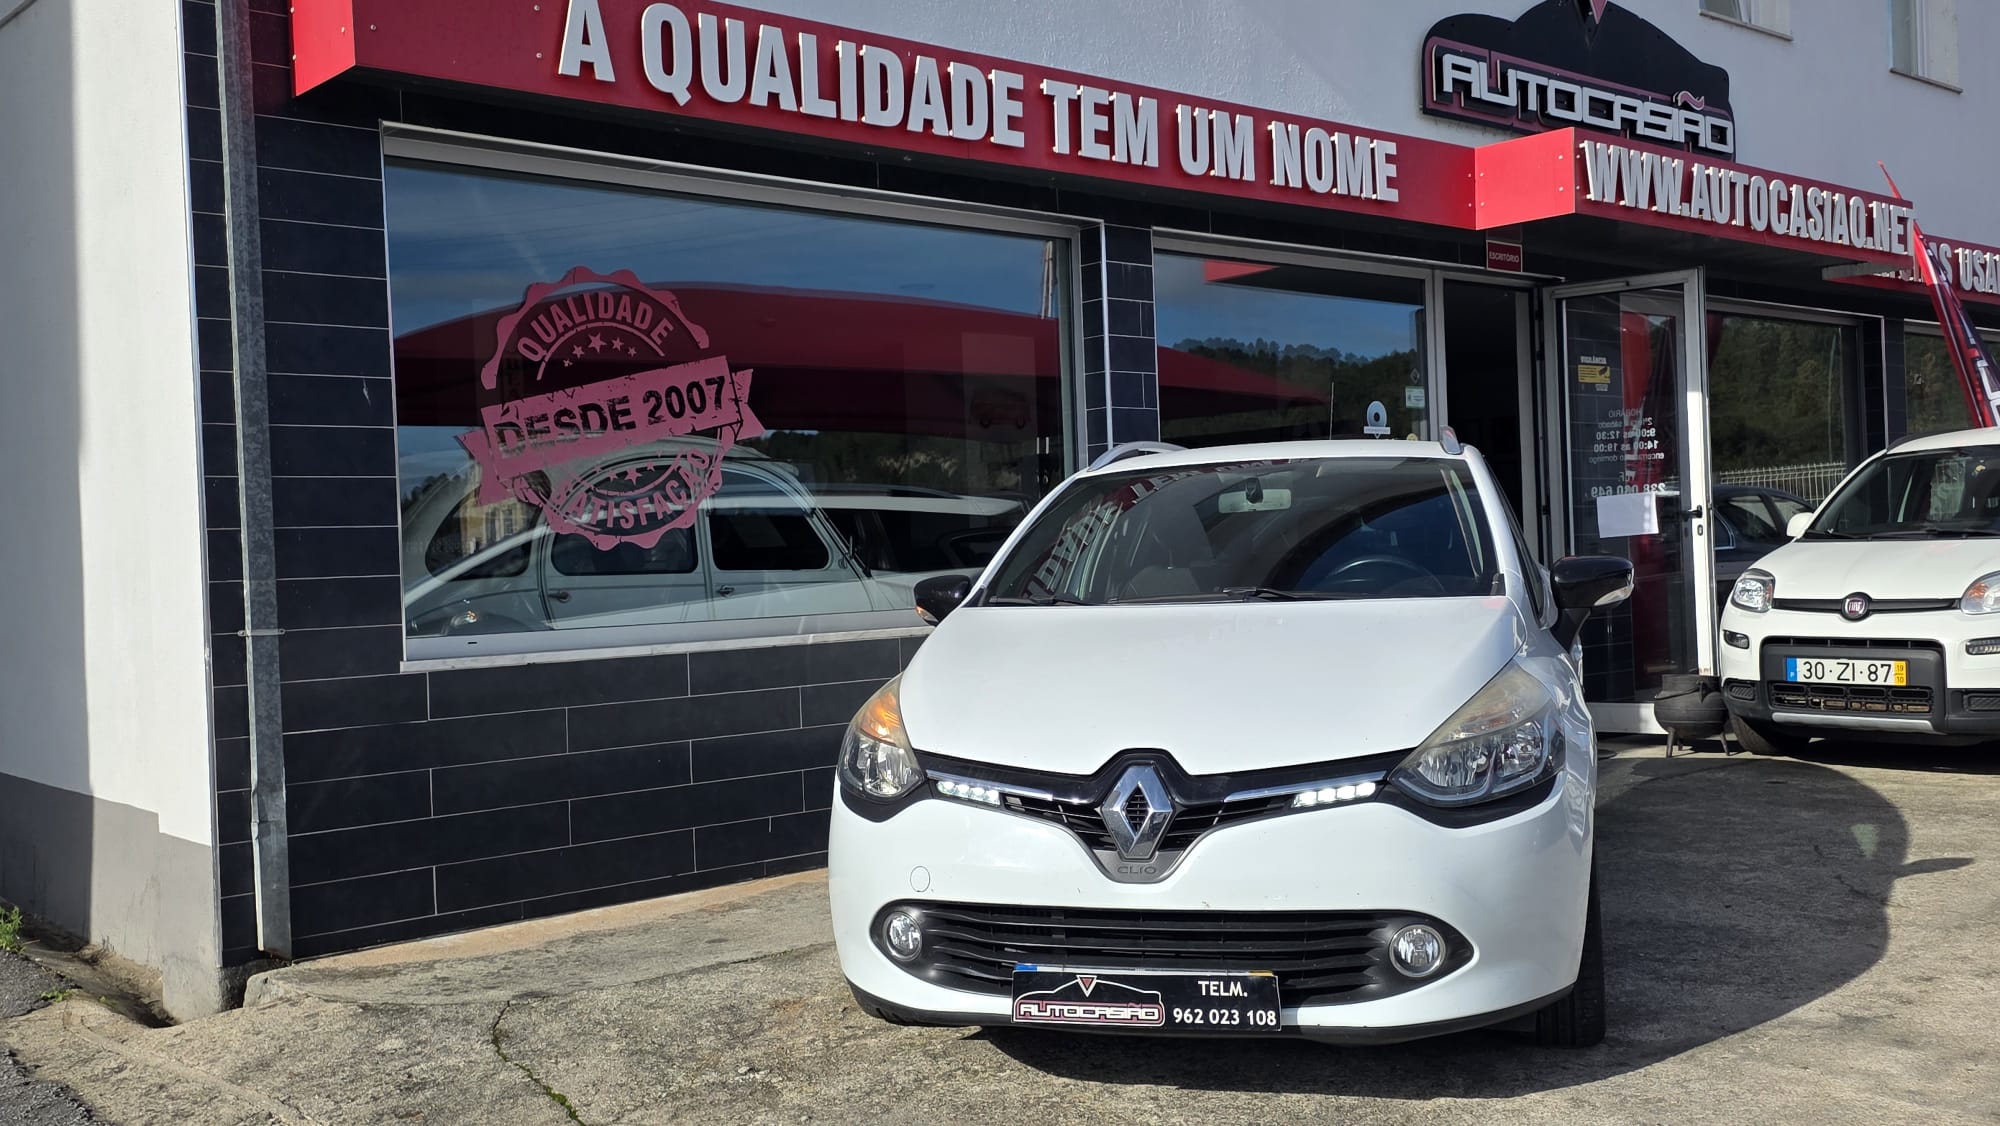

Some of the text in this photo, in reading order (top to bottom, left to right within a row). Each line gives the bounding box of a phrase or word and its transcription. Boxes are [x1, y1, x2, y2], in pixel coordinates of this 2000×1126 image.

[558, 0, 1399, 202] A QUALIDADE TEM UM NOME
[1443, 53, 1735, 154] AUTOCASIÃO
[1579, 139, 1915, 257] WWW.AUTOCASIAO.NET
[1954, 247, 2000, 294] USA
[517, 291, 675, 362] QUALIDADE
[493, 375, 727, 456] DESDE 2007
[1117, 866, 1156, 875] CLIO
[1019, 1002, 1159, 1021] AUTOCASIÃO
[1173, 1008, 1277, 1026] 962 023 108
[1198, 980, 1248, 998] TELM.
